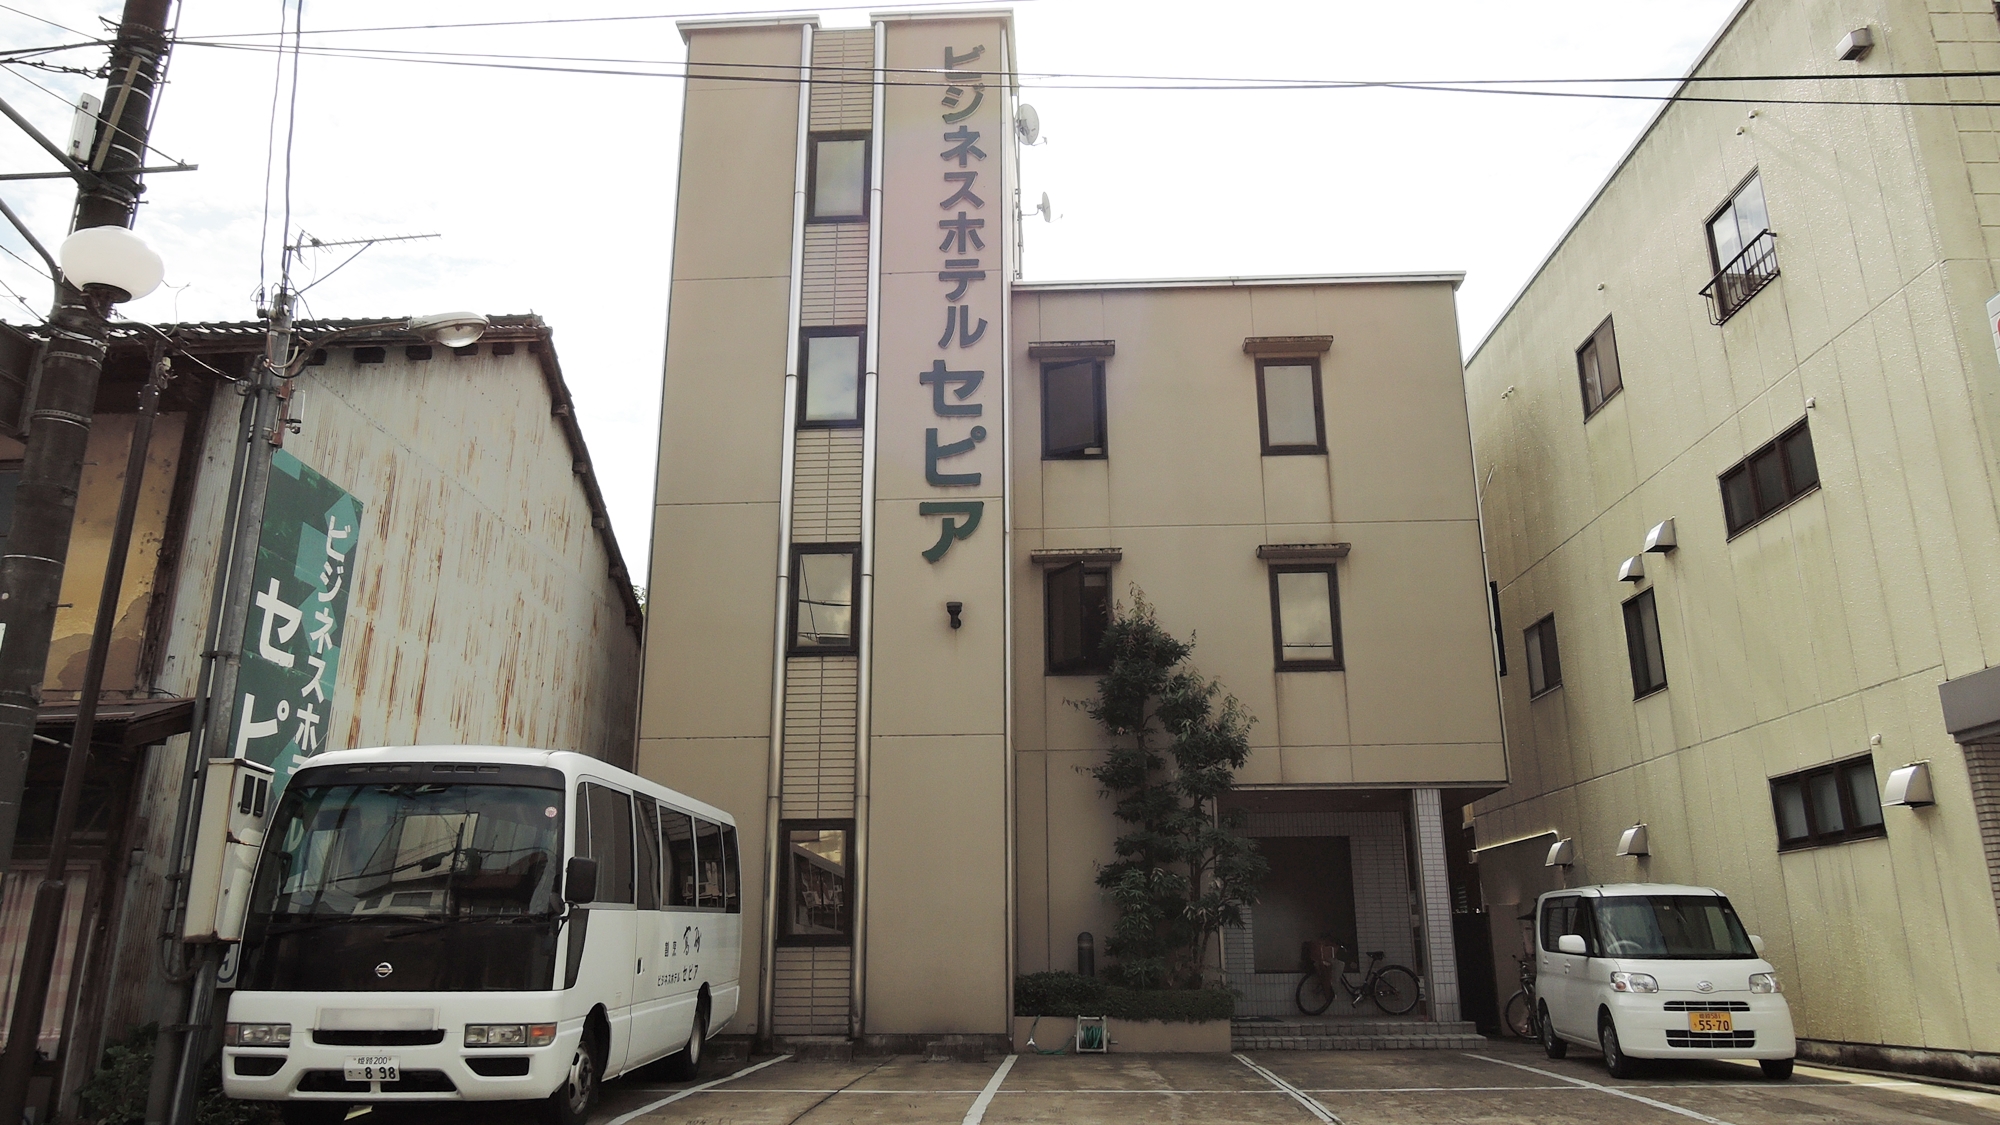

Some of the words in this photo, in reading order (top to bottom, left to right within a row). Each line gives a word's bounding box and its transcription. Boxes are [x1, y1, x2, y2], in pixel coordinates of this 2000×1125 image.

[939, 44, 987, 348] ビジネスホテル
[919, 360, 987, 564] セピア
[1698, 1020, 1730, 1031] 55-70
